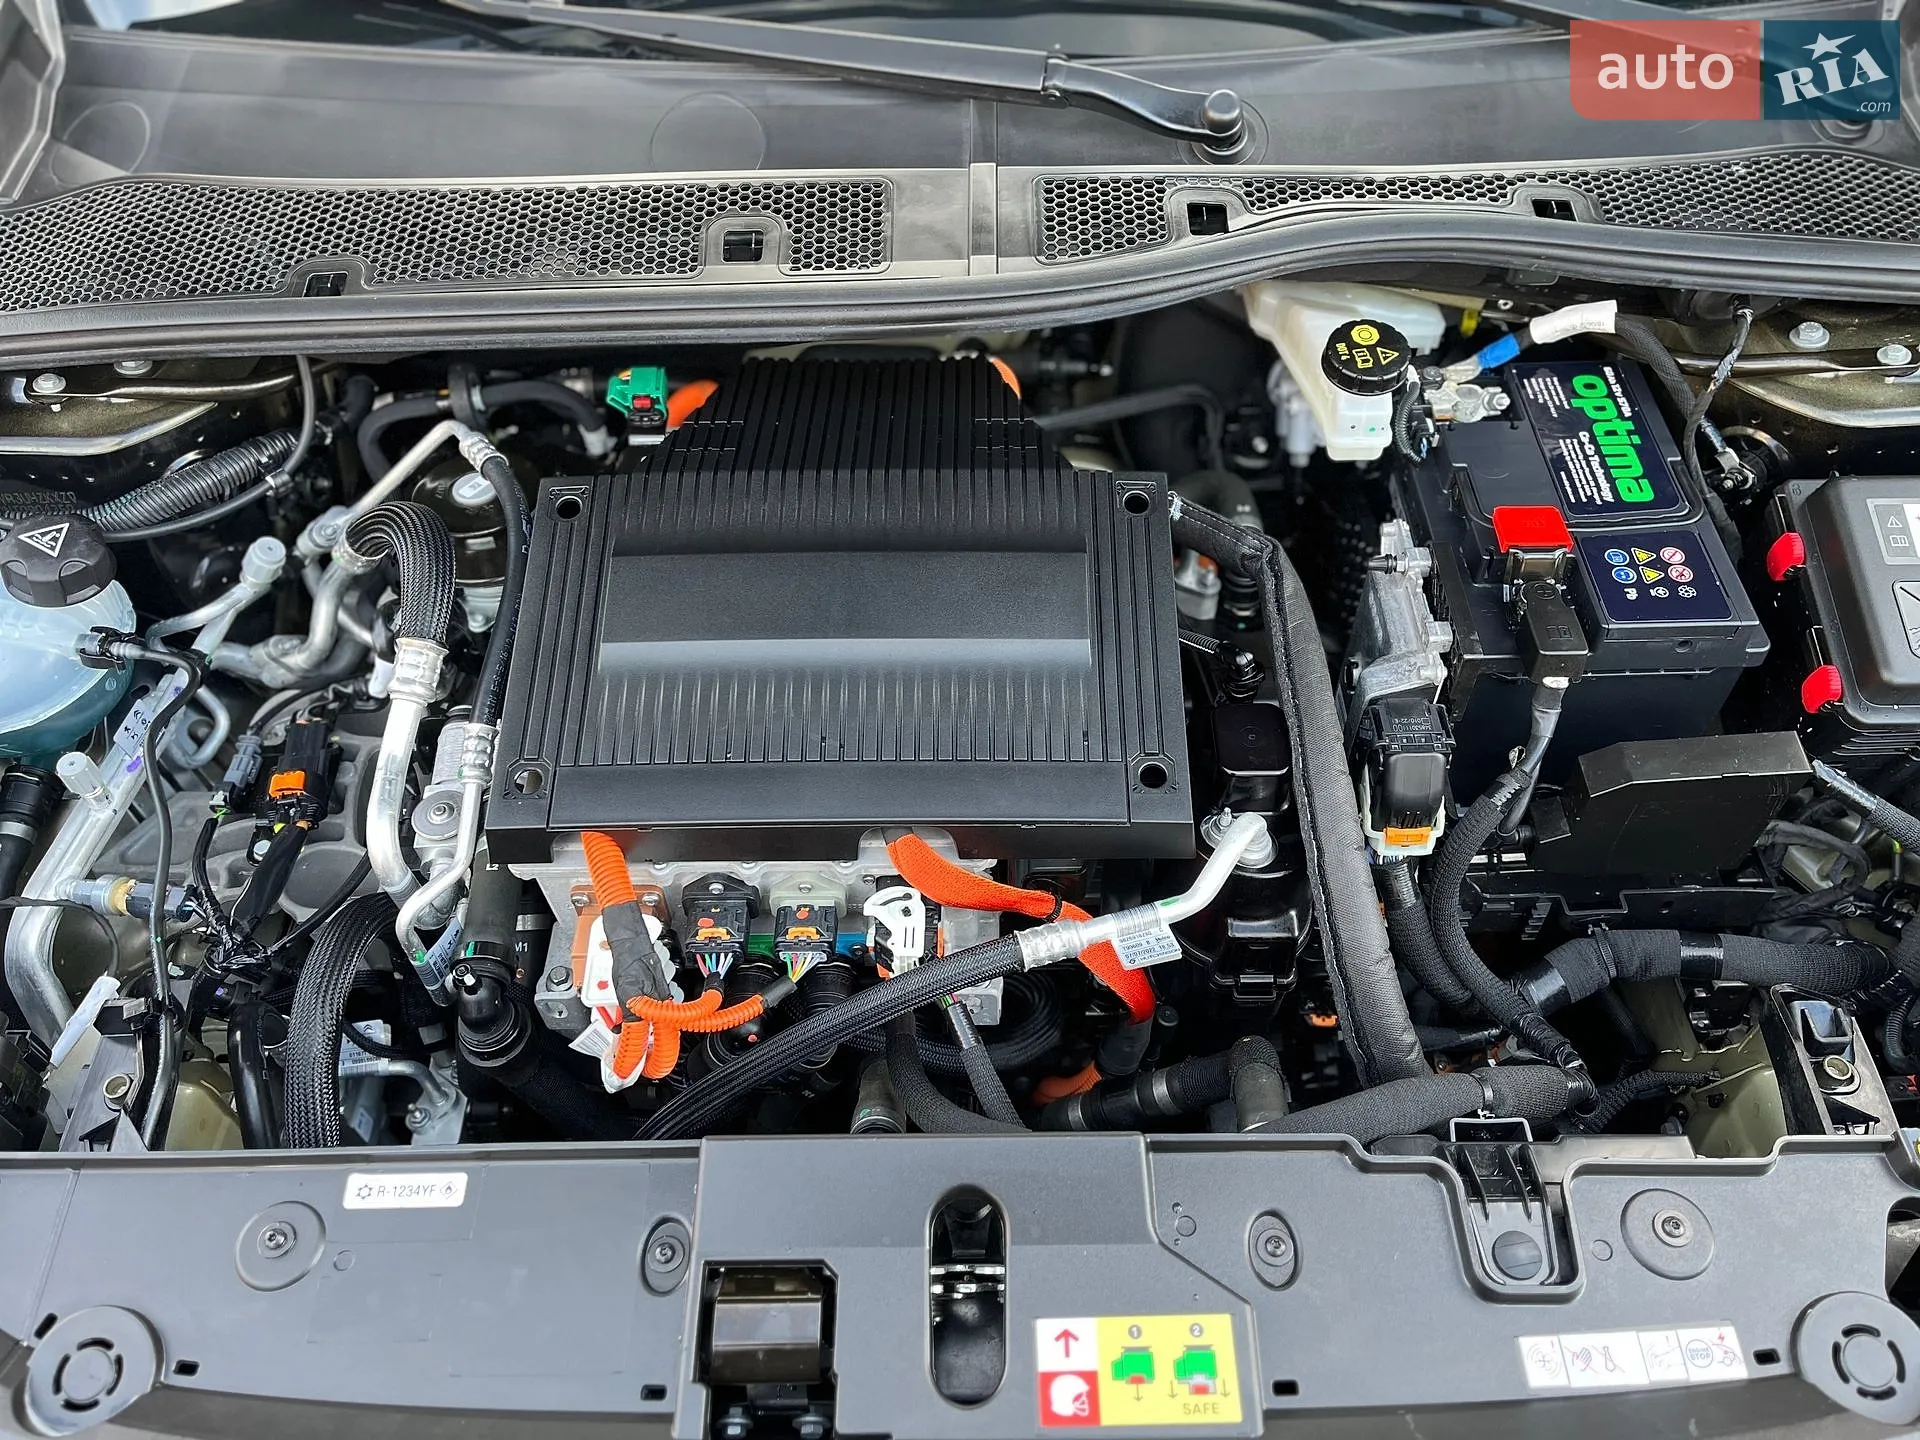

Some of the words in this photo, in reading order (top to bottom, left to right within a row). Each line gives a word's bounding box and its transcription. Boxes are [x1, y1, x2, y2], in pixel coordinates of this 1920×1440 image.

[1336, 342, 1349, 354] DOT
[1570, 374, 1655, 502] optima
[1589, 455, 1614, 502] Technology
[1624, 587, 1638, 600] Pb
[377, 1184, 437, 1198] R-1234YF
[1183, 1402, 1220, 1415] SAFE
